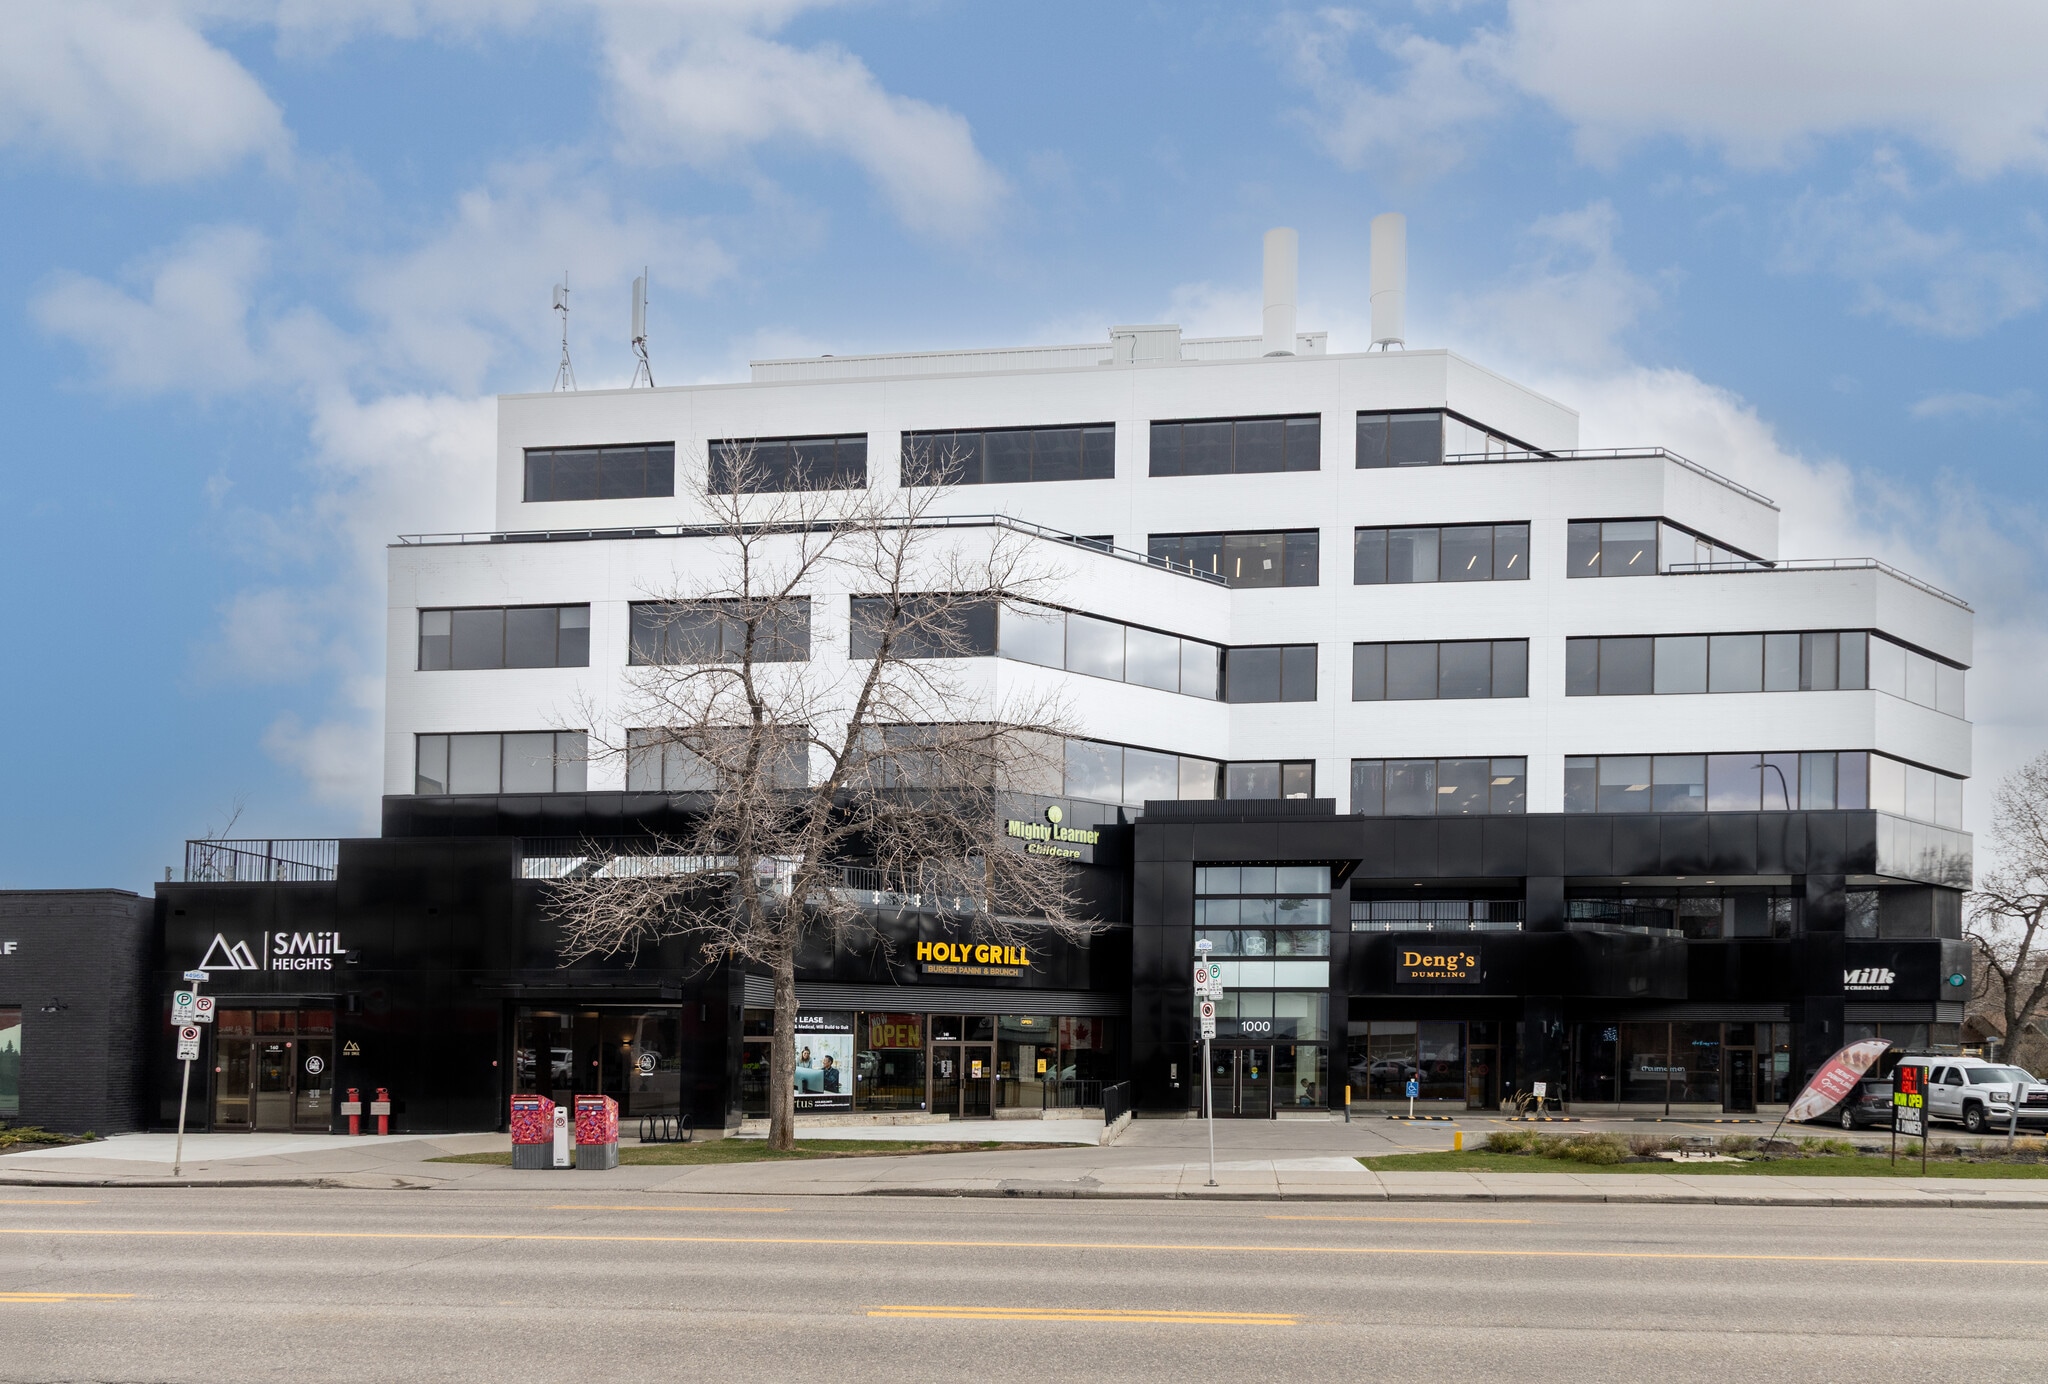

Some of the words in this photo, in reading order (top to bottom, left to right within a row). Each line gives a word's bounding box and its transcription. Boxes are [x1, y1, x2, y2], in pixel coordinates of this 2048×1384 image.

[1008, 820, 1051, 842] Mighty
[1053, 824, 1099, 844] Learner
[1028, 843, 1080, 858] Childcare
[0, 941, 17, 955] F
[917, 941, 972, 963] HOLY
[975, 944, 1030, 966] GRILL
[272, 958, 333, 970] HEIGHTS
[1403, 952, 1475, 971] Deng's
[927, 965, 957, 974] BURGER
[959, 967, 981, 975] PANINI
[990, 968, 1018, 976] BRUNCH
[1844, 968, 1896, 984] Milk
[800, 1016, 824, 1024] LEASE
[872, 1015, 888, 1026] NOW
[1241, 1021, 1271, 1032] 1000
[872, 1024, 920, 1047] OPEN
